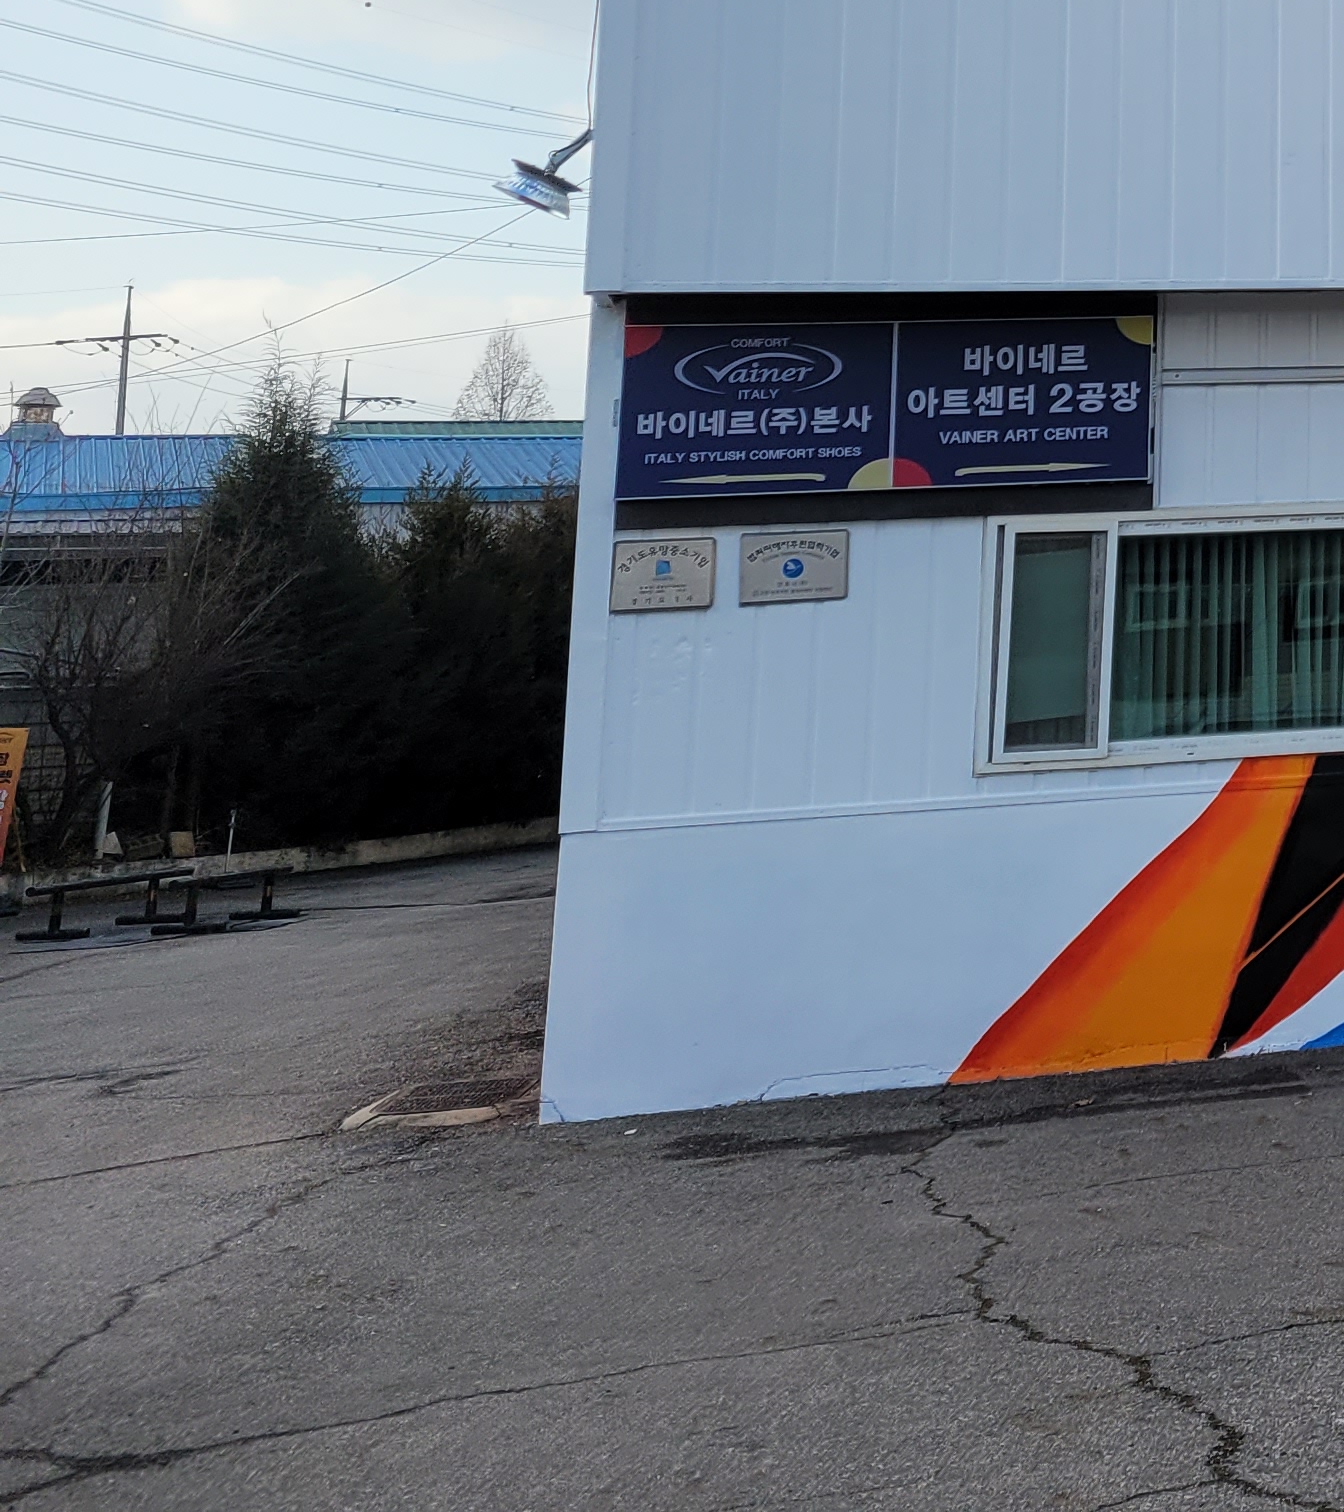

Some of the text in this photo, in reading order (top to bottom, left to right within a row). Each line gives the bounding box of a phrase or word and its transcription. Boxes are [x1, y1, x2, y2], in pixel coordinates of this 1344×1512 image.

[730, 337, 791, 349] COMFORT
[703, 352, 817, 384] Vainer
[963, 343, 1089, 376] 바이네르
[737, 389, 780, 400] ITALY
[907, 381, 1141, 419] 아트센터 2공장
[636, 405, 872, 439] 바이네르(주)본사
[939, 426, 1109, 444] VAINER ART CENTER
[644, 446, 862, 465] ITALY STYLISH COMFORT SHOES
